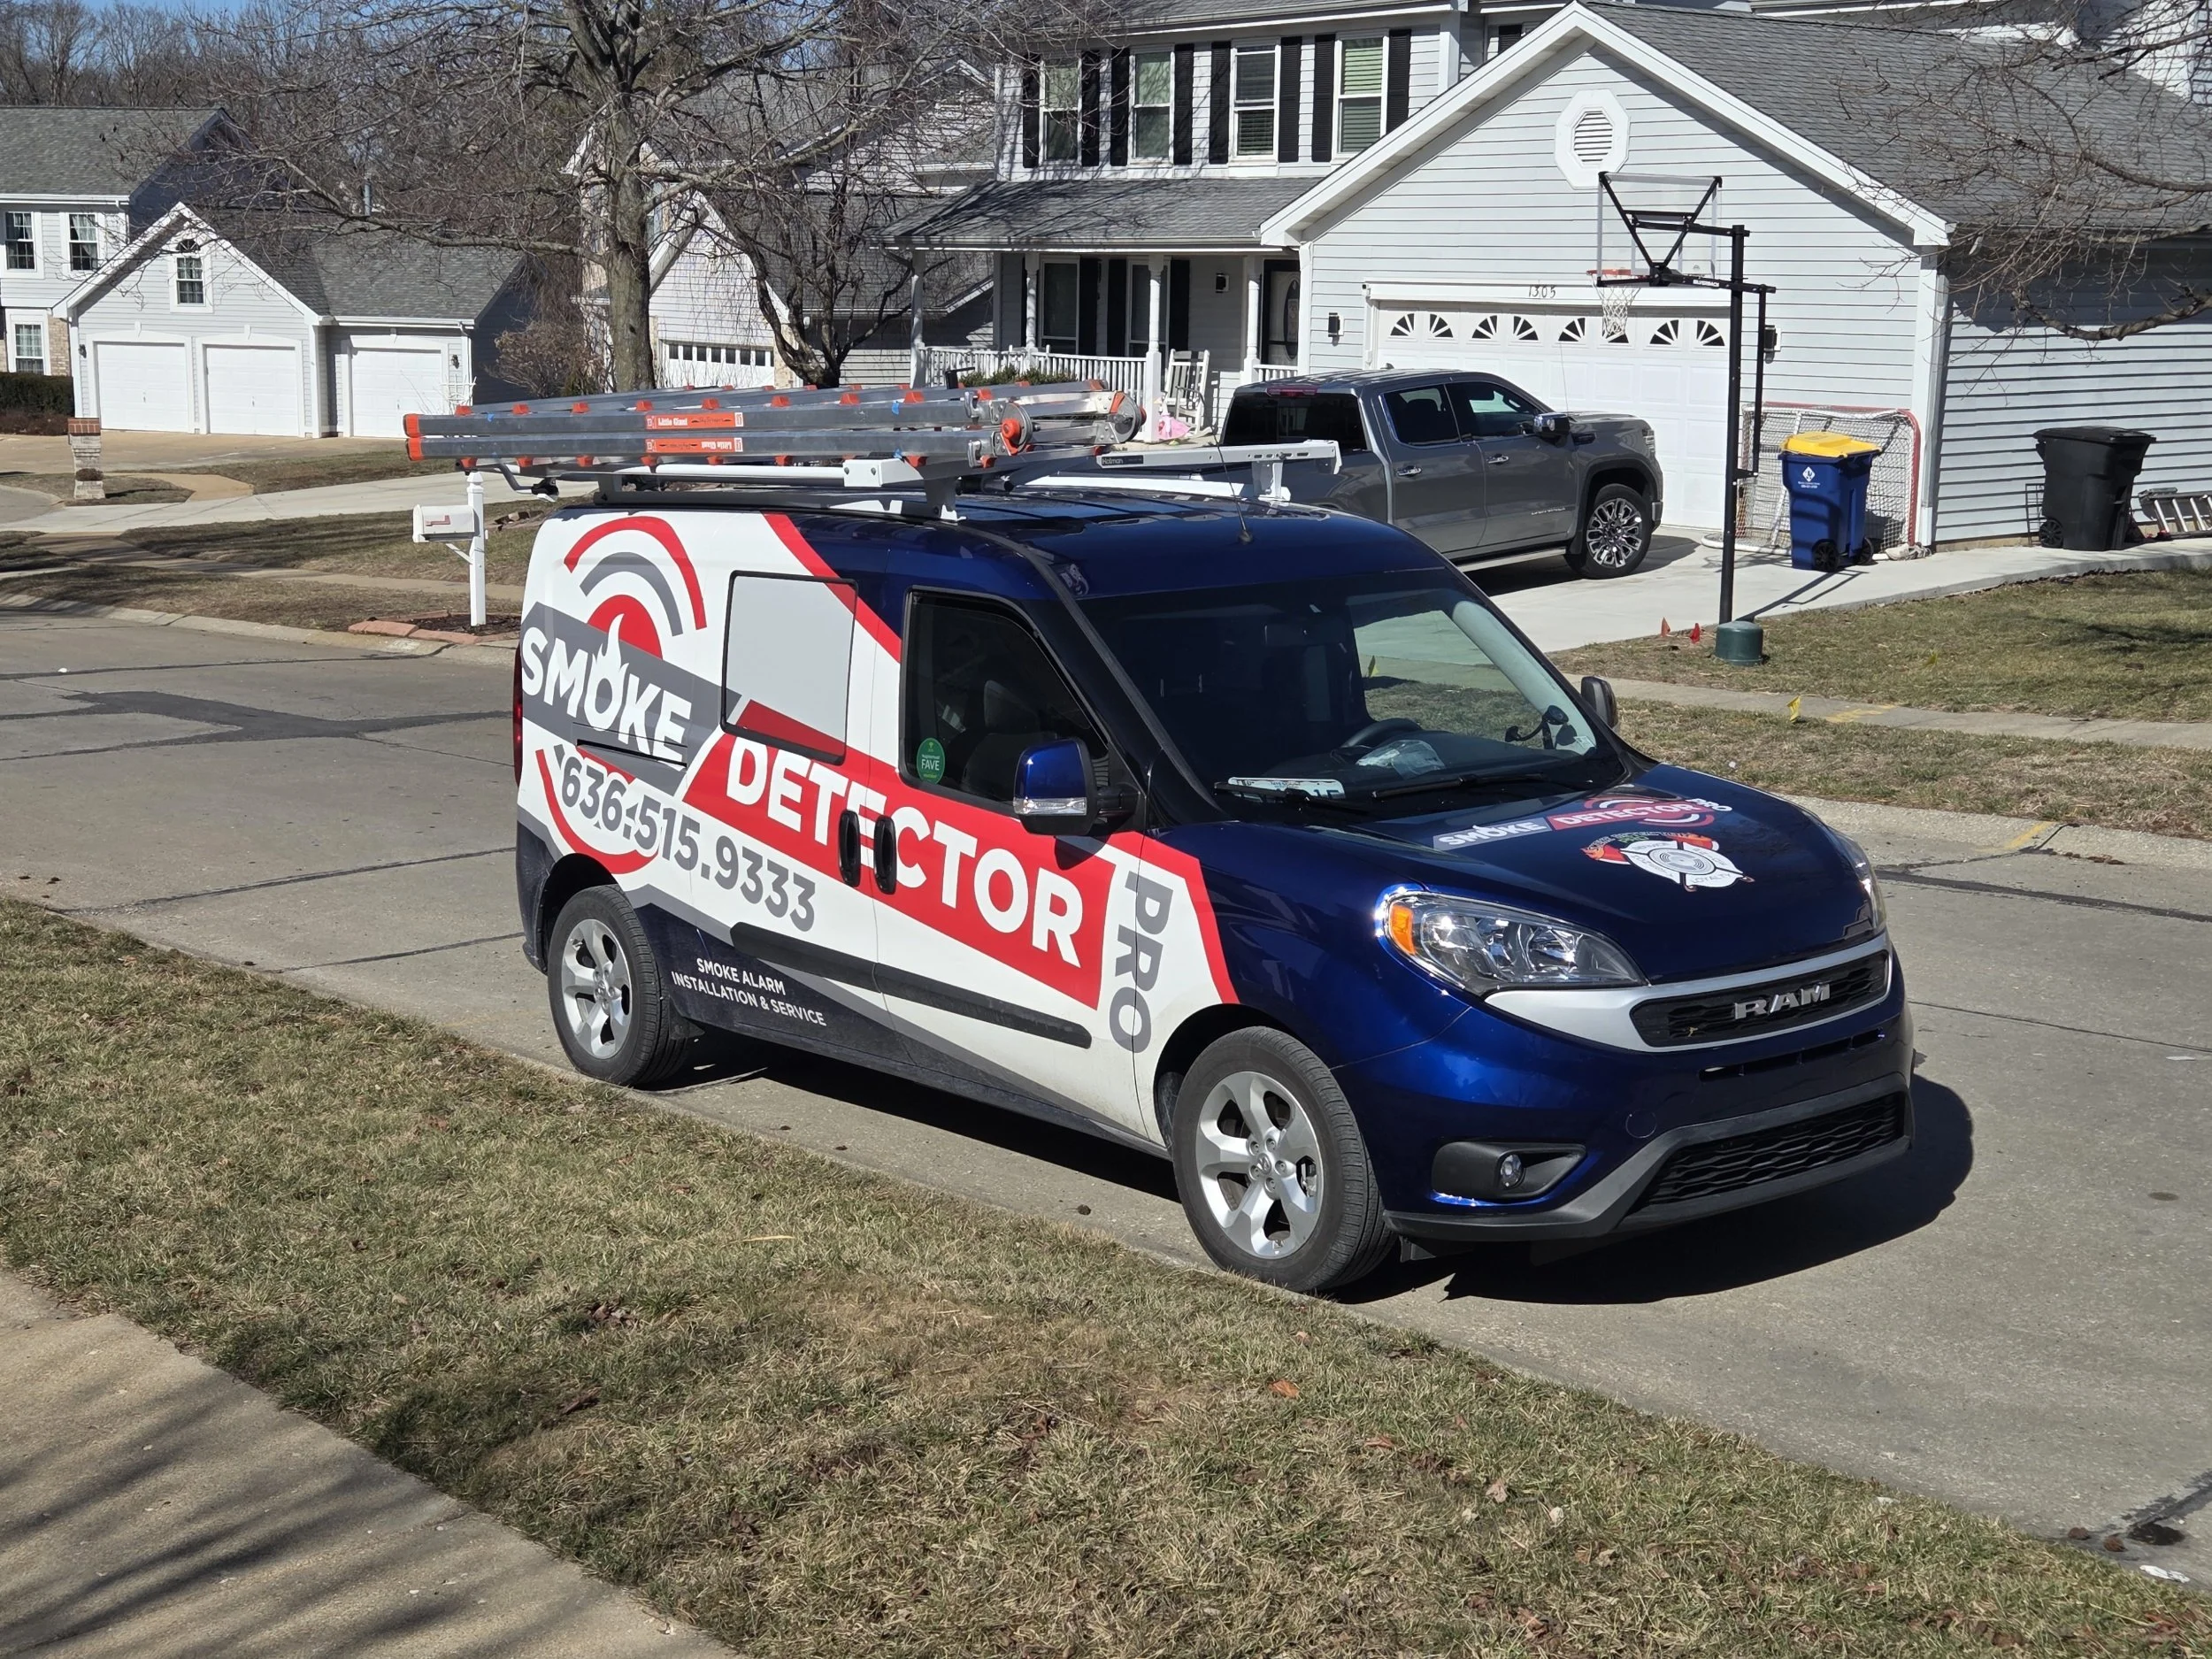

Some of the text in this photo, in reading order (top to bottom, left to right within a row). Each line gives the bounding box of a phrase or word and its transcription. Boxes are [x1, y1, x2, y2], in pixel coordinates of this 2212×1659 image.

[1529, 284, 1555, 298] 1305
[522, 614, 692, 772] SMOKE
[921, 758, 940, 771] FAVE
[562, 757, 816, 932] 636.515.9333
[1439, 798, 1733, 845] SMOKE DETECTOR PRO
[726, 736, 1083, 969] DETECTOR
[696, 957, 786, 995] SMOKE ALARM
[1110, 871, 1173, 1053] PRO
[672, 971, 827, 1026] INSTALLATION & SERVICE
[1734, 983, 1831, 1019] RAM
